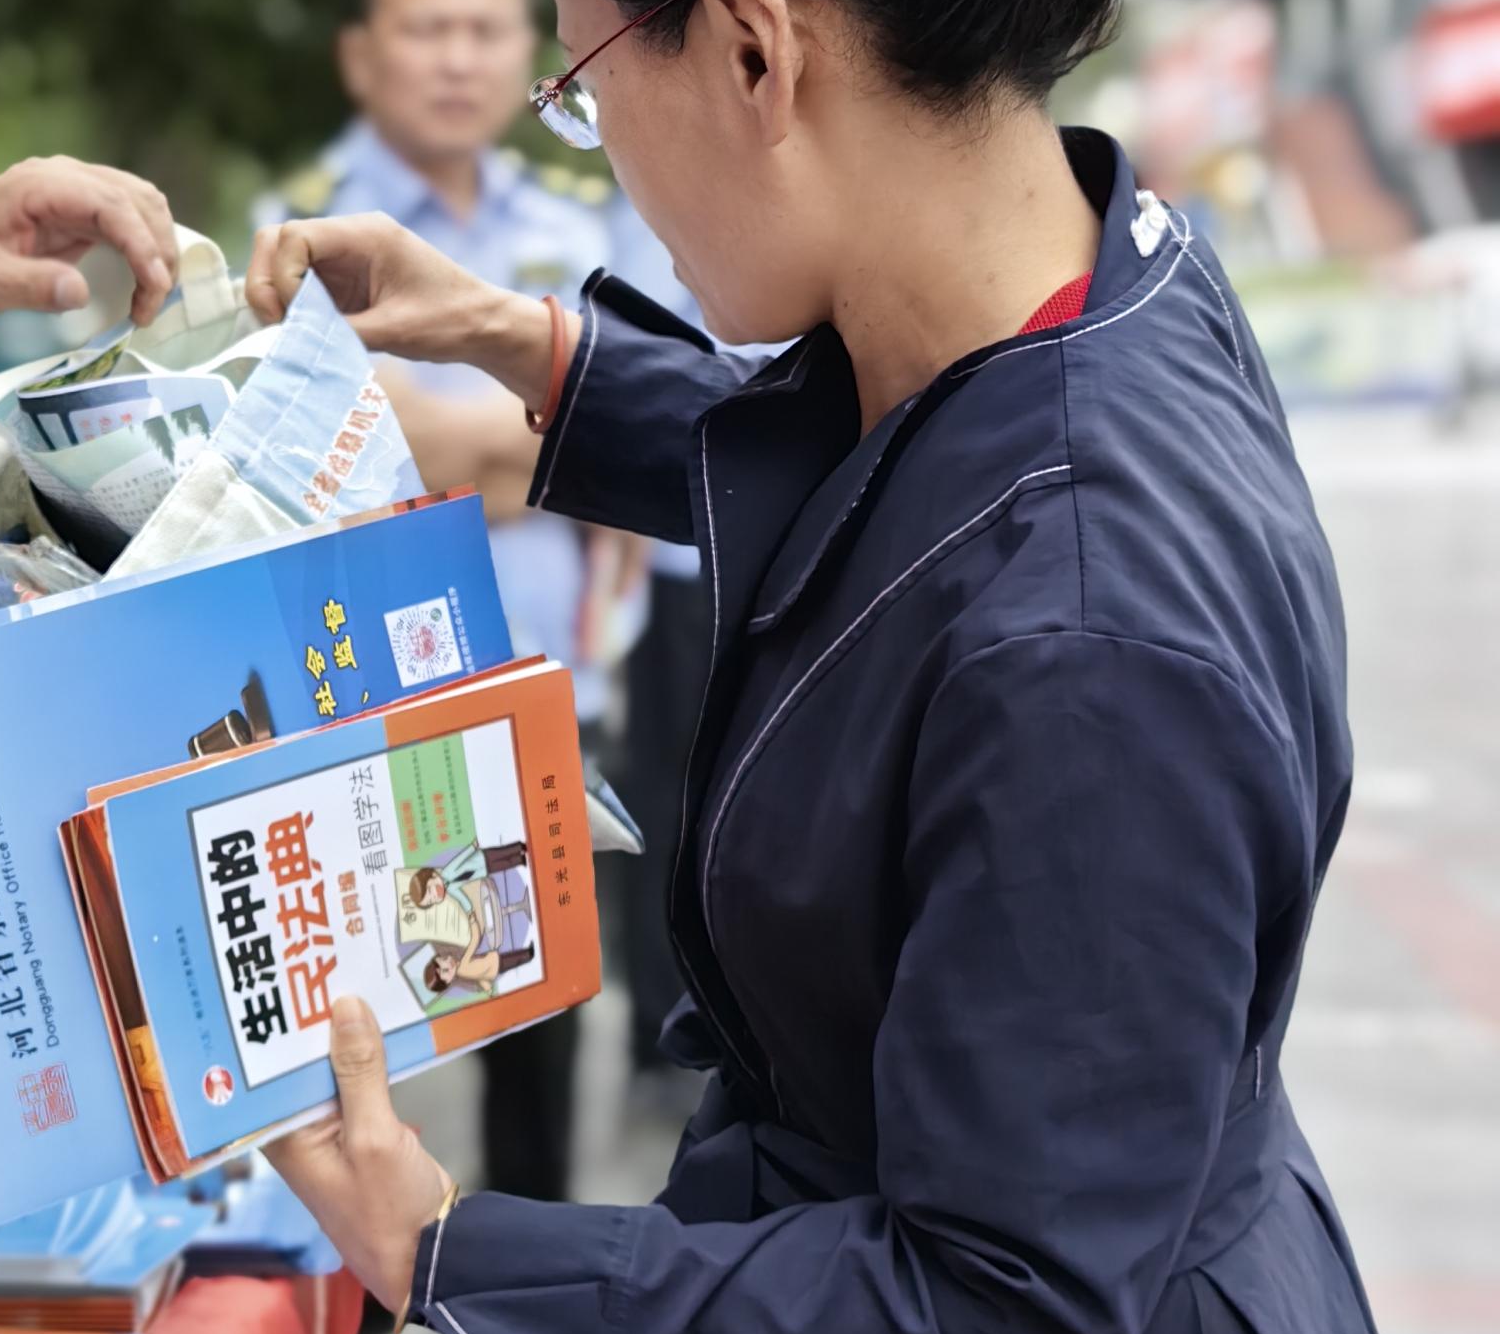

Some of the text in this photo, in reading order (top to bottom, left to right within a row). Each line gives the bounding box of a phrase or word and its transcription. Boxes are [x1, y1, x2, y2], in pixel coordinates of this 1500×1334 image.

[305, 644, 337, 717] 社会
[349, 764, 389, 877] 看图学法
[541, 774, 571, 907] 东光县司法局
[15, 899, 37, 955] Notary
[206, 828, 288, 1045] 生活中的
[264, 810, 338, 1031] 民法典
[337, 870, 365, 938] 合同编
[30, 959, 60, 1049] Dongguang
